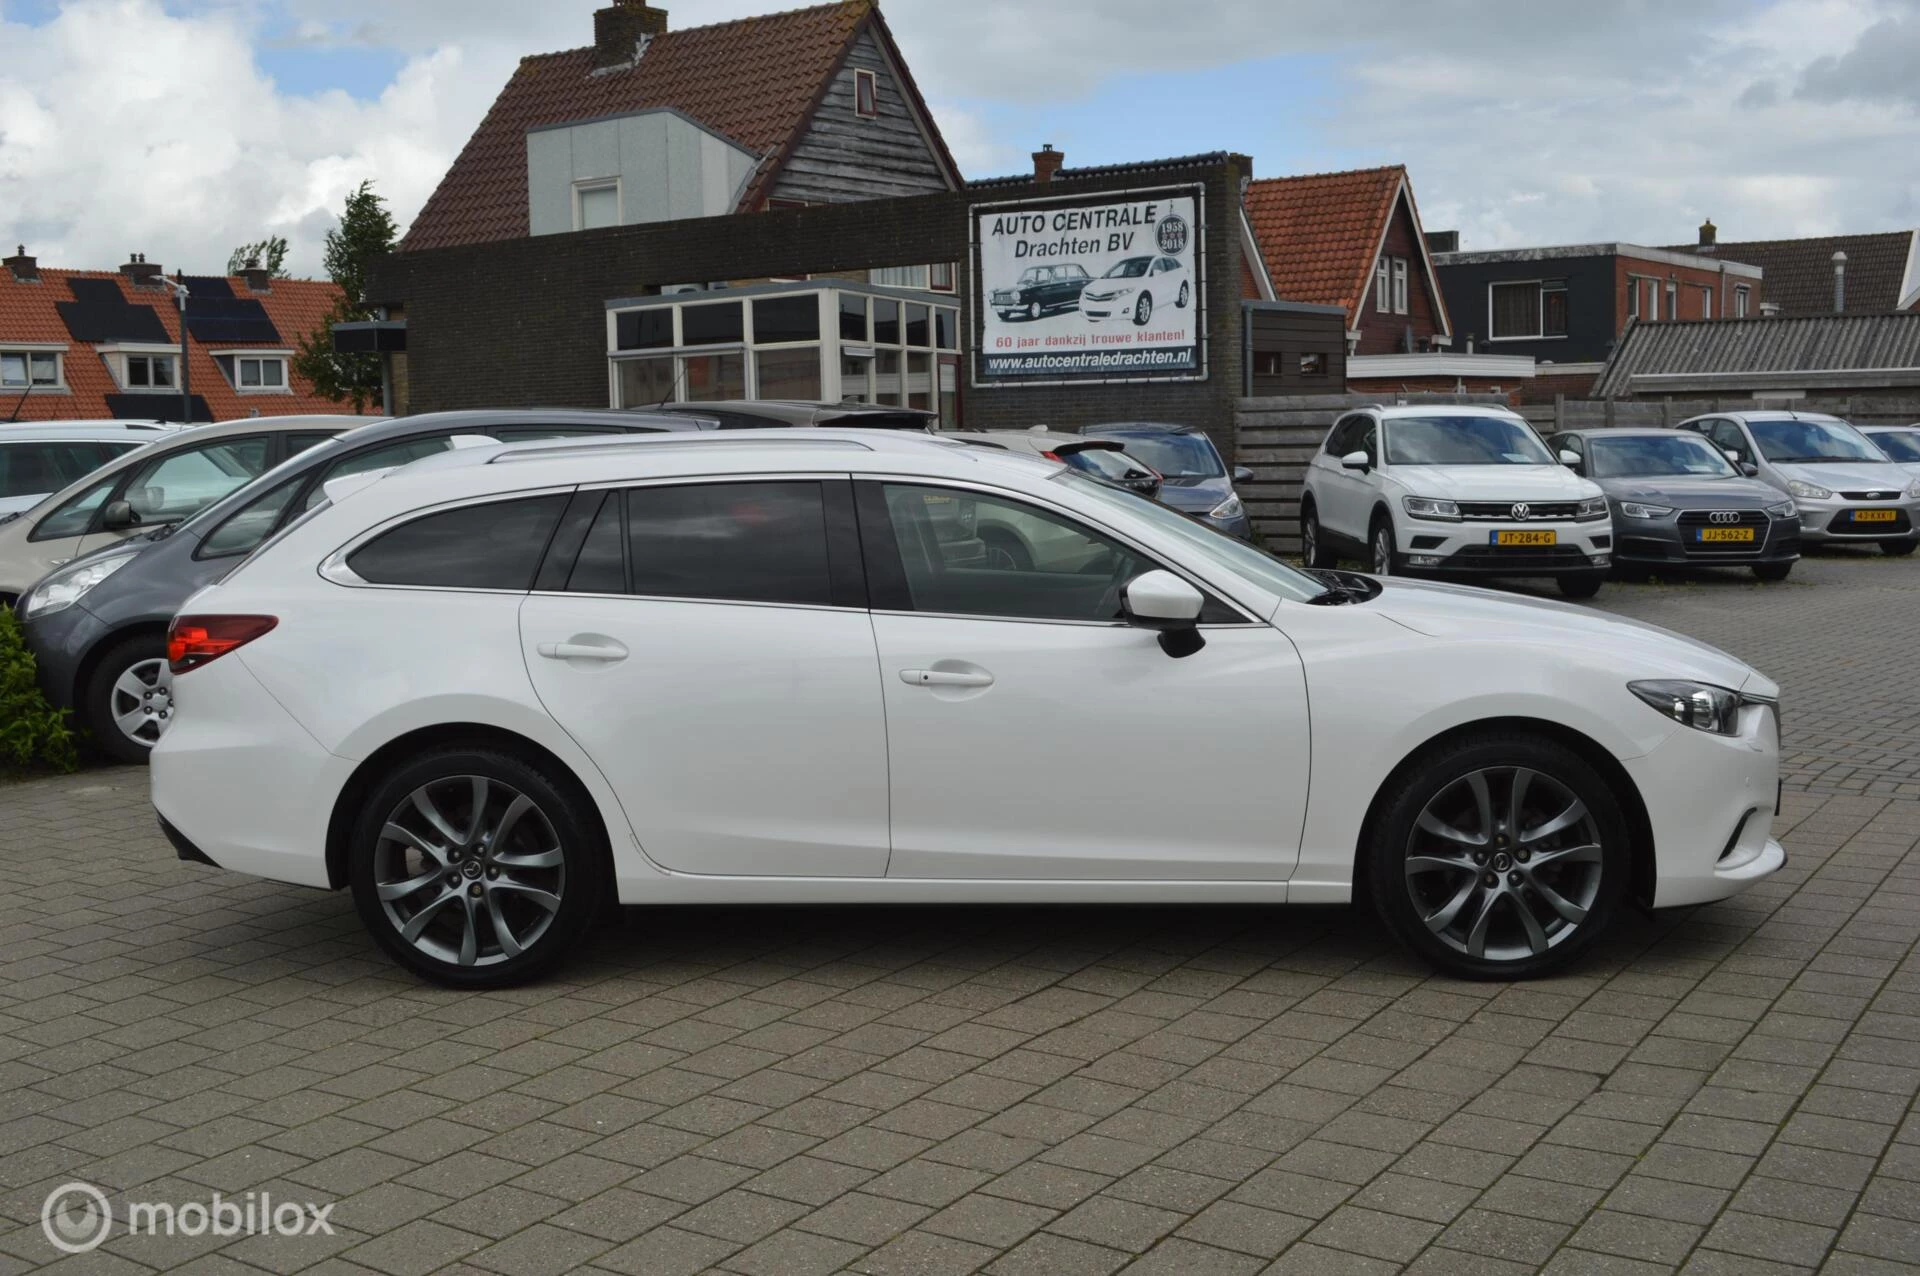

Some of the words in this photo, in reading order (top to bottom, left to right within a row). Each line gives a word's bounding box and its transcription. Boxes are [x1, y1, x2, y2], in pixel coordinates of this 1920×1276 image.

[992, 214, 1045, 236] AUTO
[1053, 205, 1158, 232] CENTRALE
[1161, 221, 1184, 233] 1958
[1015, 237, 1101, 258] Drachten
[1107, 231, 1135, 251] BV
[1161, 238, 1184, 250] 2018
[995, 336, 1012, 348] 60
[1017, 336, 1040, 349] jaar
[1045, 333, 1086, 346] dankzij
[1091, 333, 1132, 344] trouwe
[1137, 329, 1185, 342] klanten!
[988, 348, 1191, 369] www.autocentraledrachten.nl
[1501, 533, 1551, 543] JT-284-G
[1706, 530, 1749, 540] JJ-562-Z
